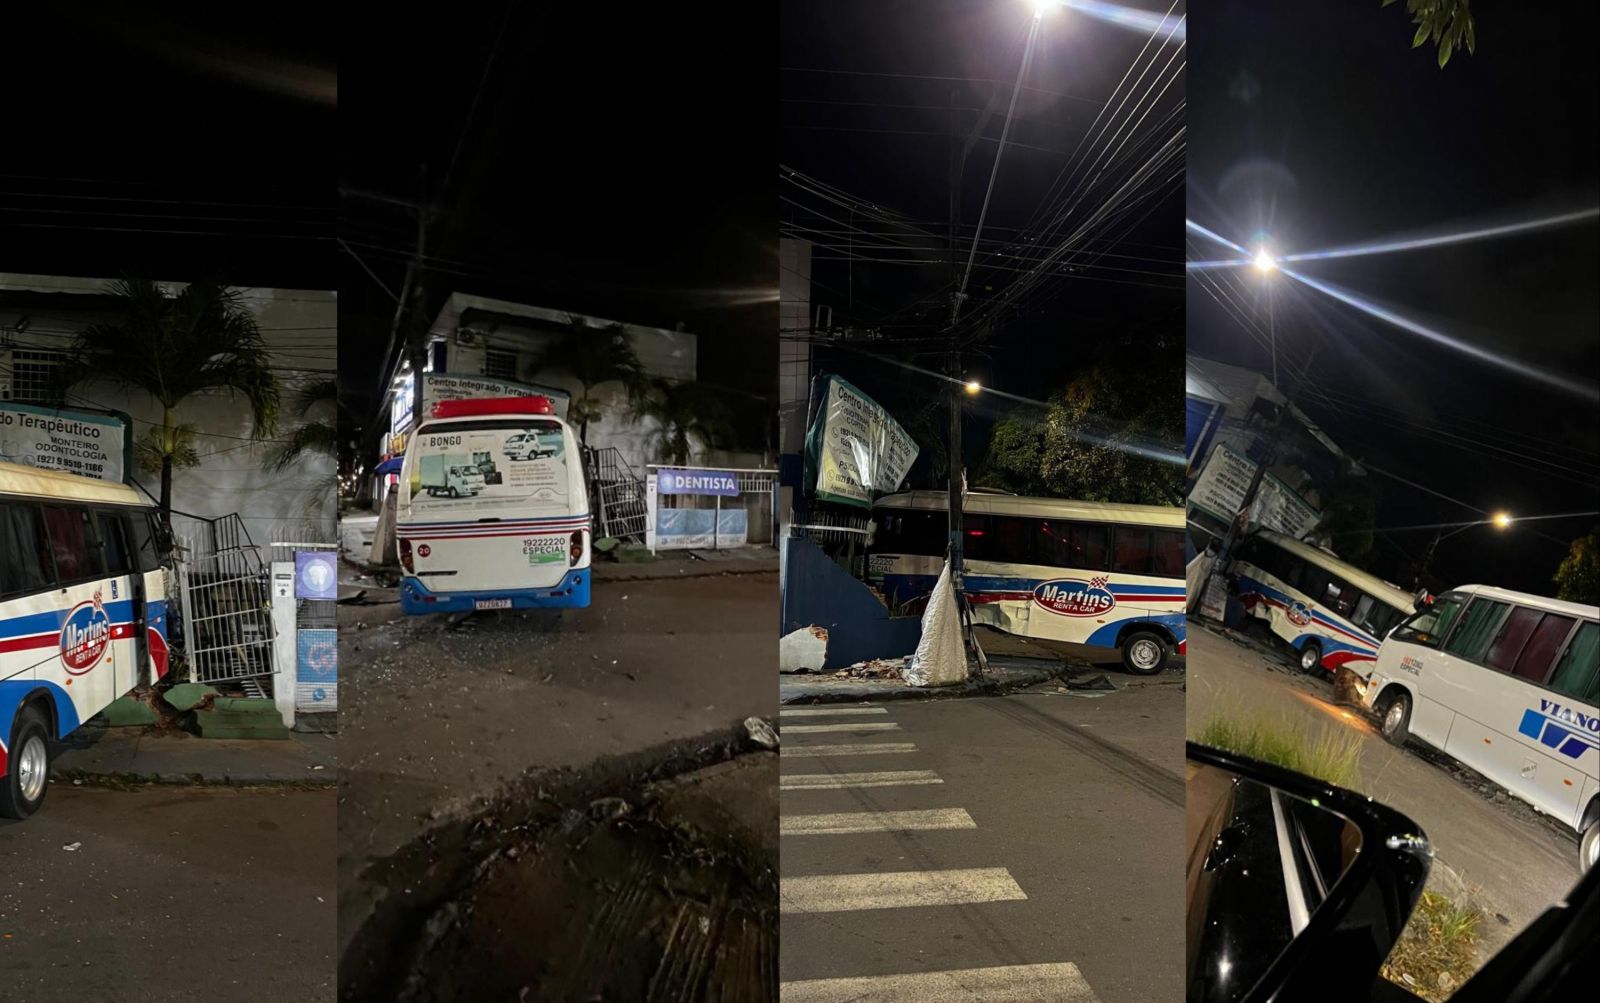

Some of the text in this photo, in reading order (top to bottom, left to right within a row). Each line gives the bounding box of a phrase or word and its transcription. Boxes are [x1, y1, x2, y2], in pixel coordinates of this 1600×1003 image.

[428, 377, 457, 387] Centro
[459, 378, 501, 393] Integrado
[838, 386, 861, 410] Centro
[17, 413, 101, 438] Terapêutico
[50, 436, 100, 451] MONTEIRO
[430, 436, 462, 447] BONGO
[35, 442, 108, 461] ODONTOLOGIA
[36, 454, 55, 464] (92)
[675, 476, 735, 490] DENTISTA
[523, 537, 566, 547] 19222220
[523, 546, 565, 555] ESPECIAL
[1041, 585, 1111, 608] Martins
[1053, 602, 1071, 610] RENT
[66, 620, 107, 657] Martins
